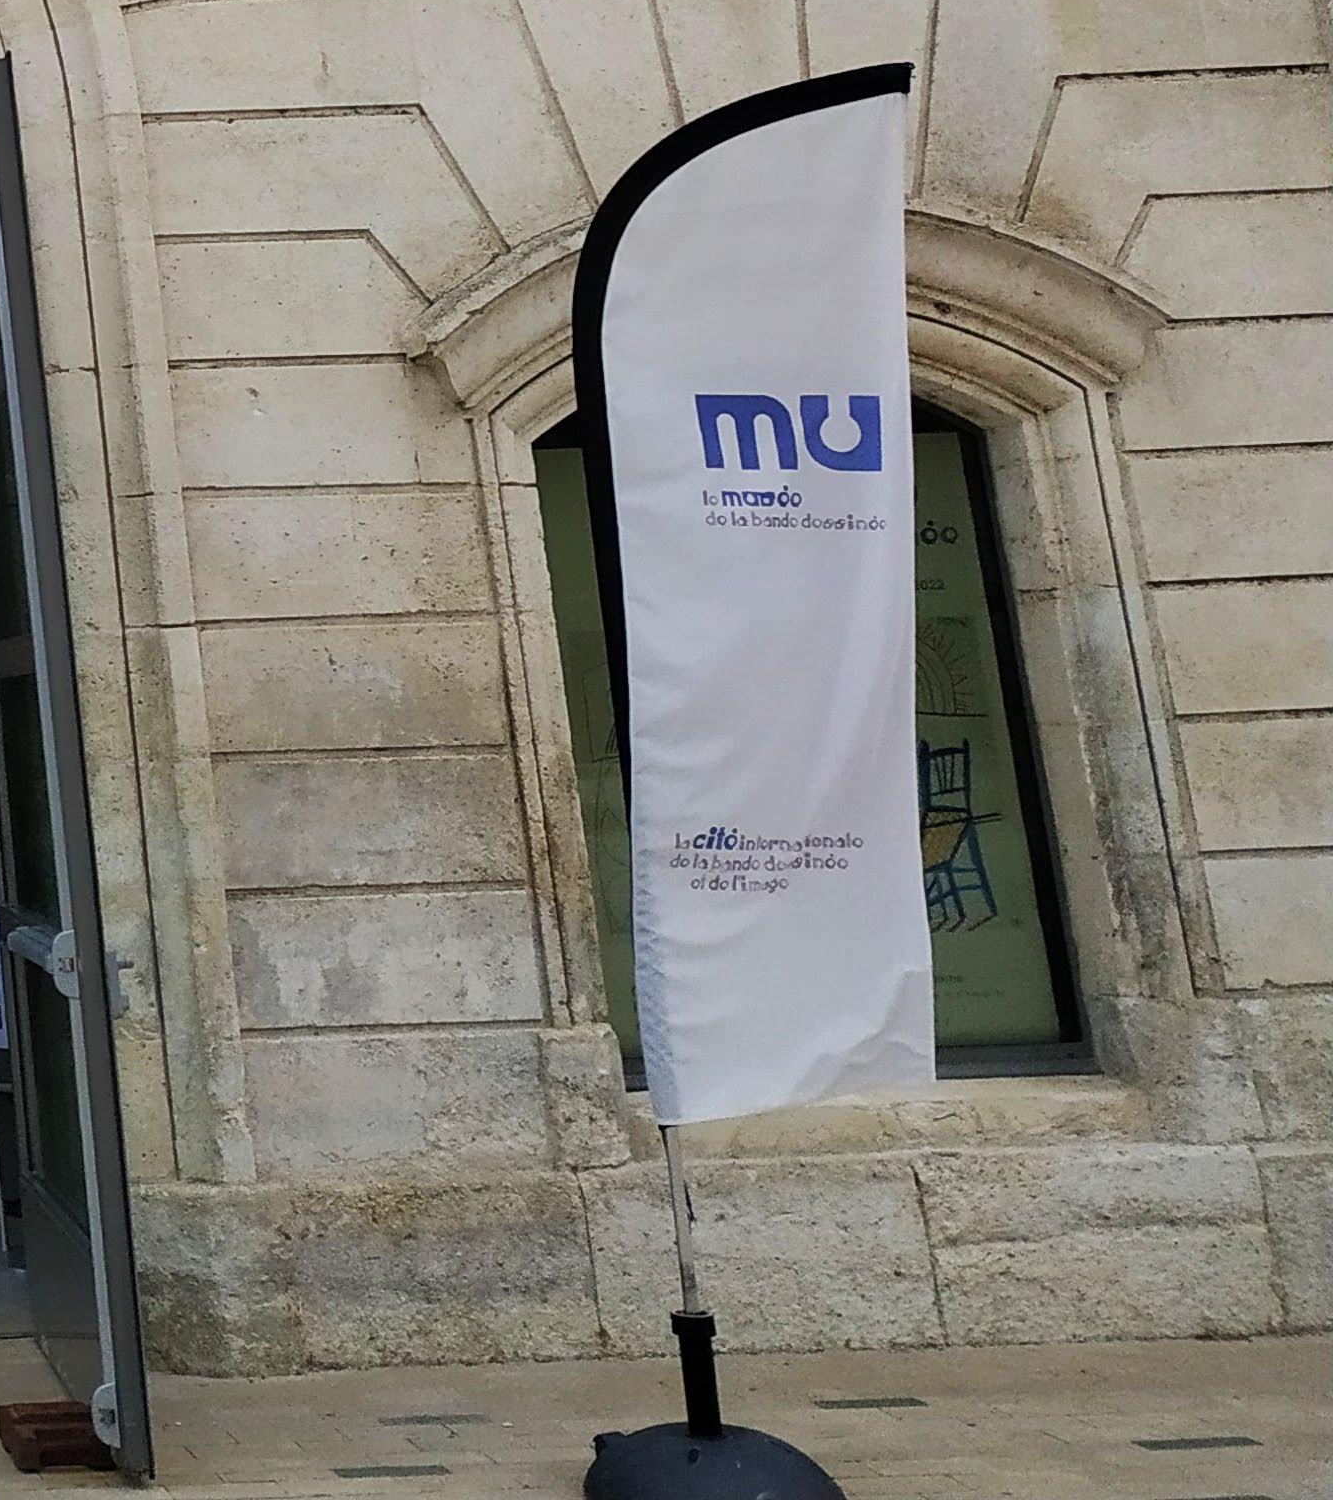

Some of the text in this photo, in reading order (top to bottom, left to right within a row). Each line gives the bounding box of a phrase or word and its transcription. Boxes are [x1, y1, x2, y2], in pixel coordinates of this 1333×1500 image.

[695, 394, 881, 471] mu
[731, 511, 748, 527] la
[693, 853, 708, 869] la
